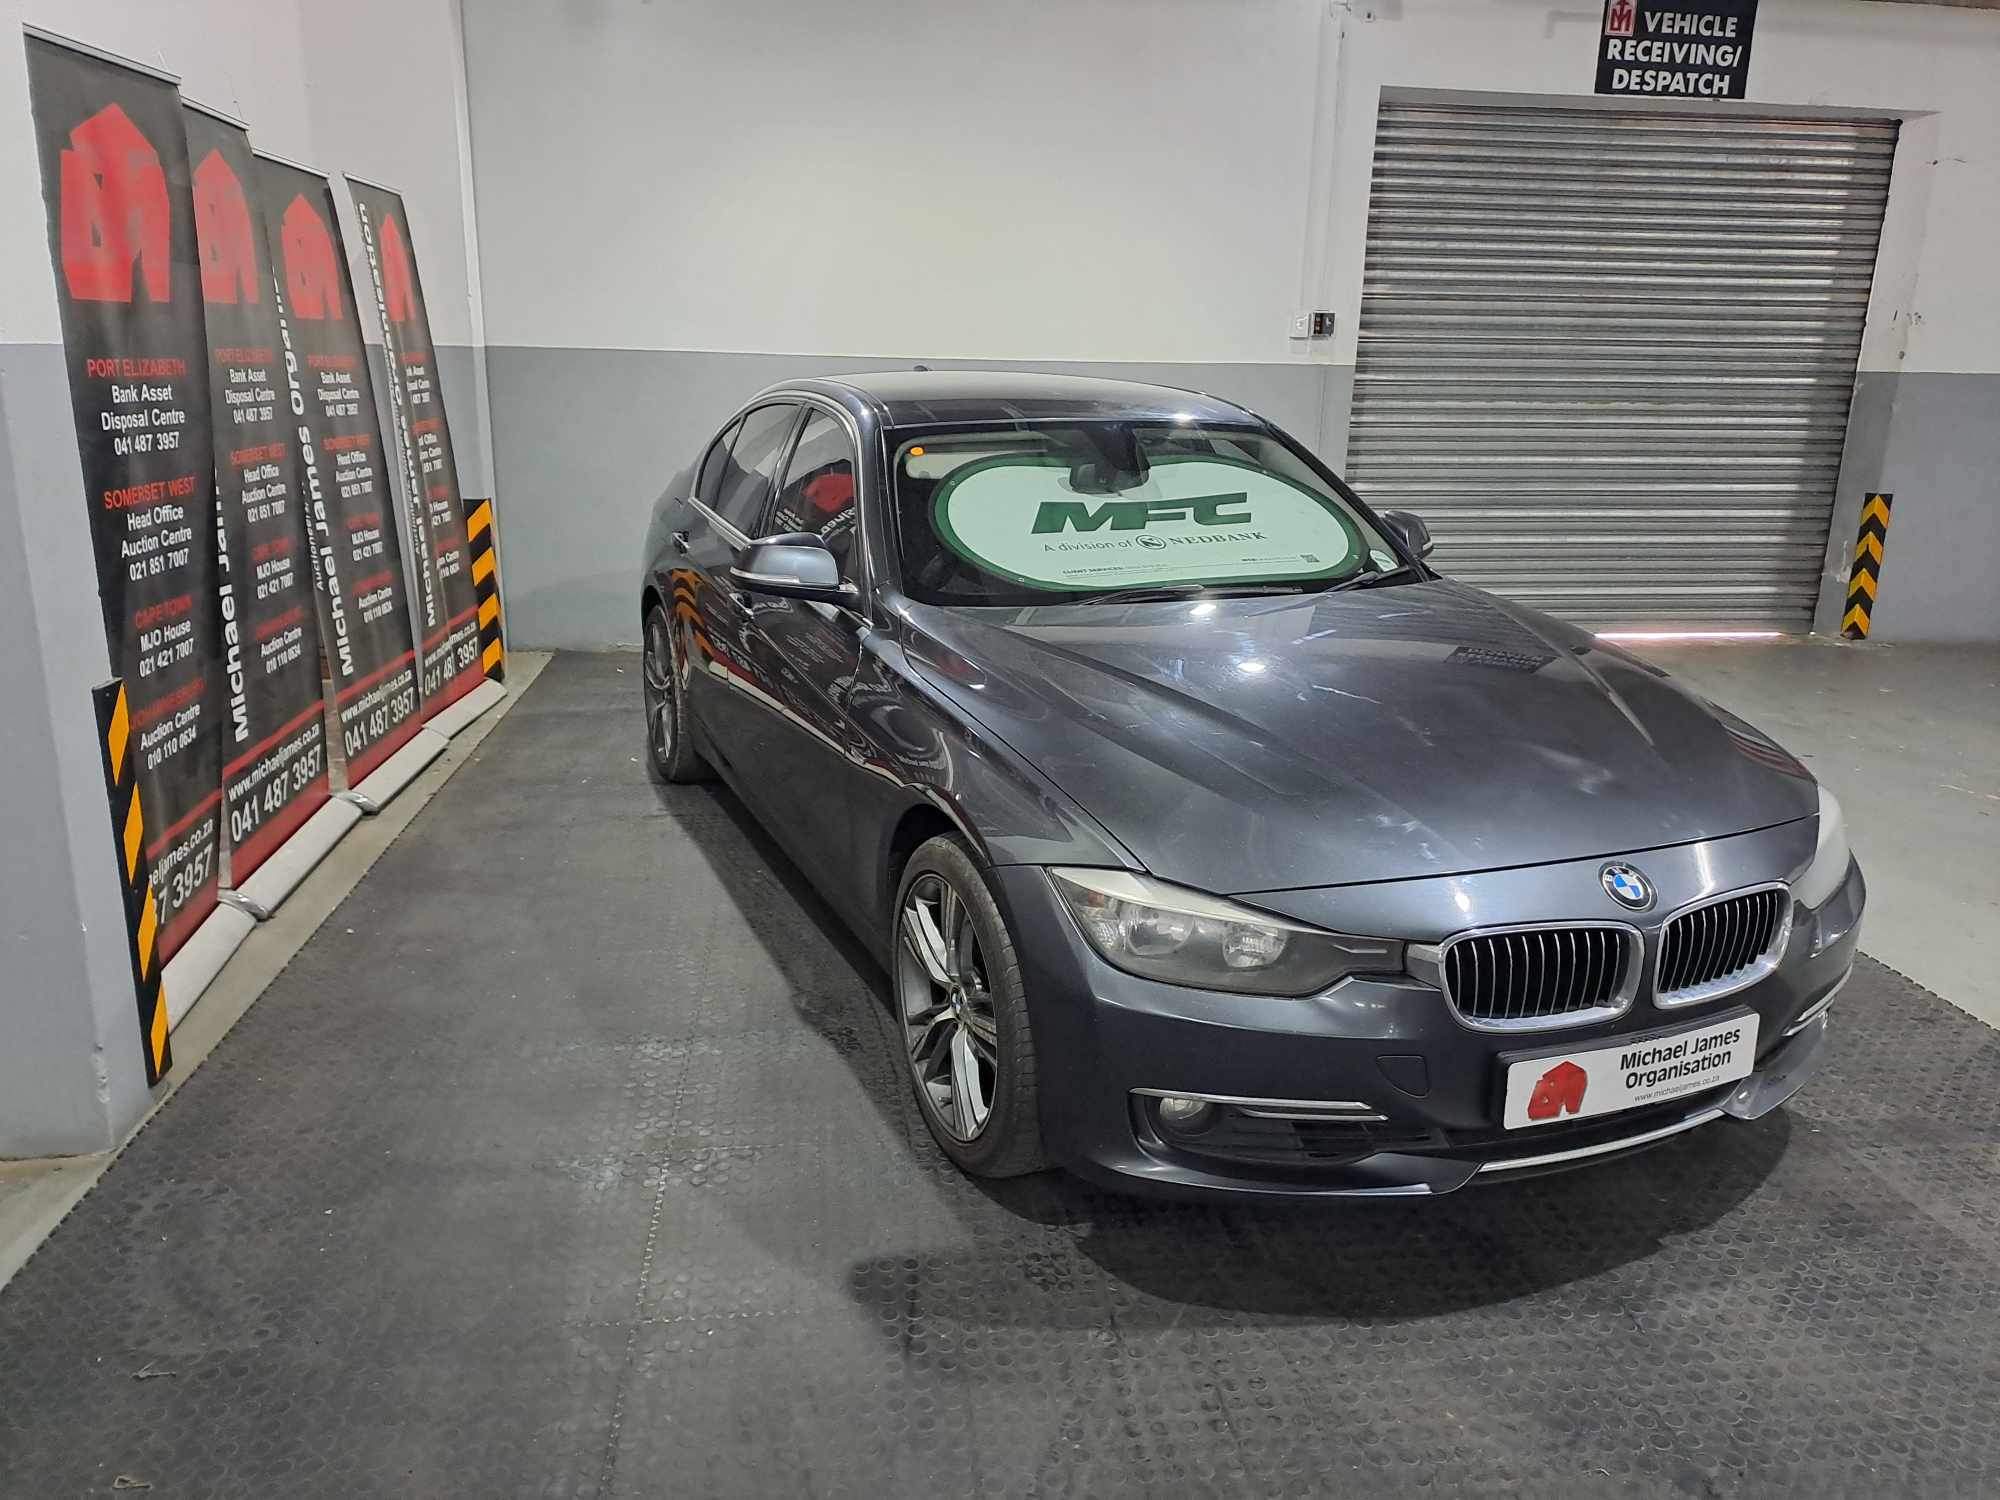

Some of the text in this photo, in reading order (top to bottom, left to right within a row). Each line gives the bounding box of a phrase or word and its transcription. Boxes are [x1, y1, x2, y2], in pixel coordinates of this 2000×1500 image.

[1644, 11, 1738, 38] VEHICLE
[1607, 38, 1743, 68] RECEIVING/
[1611, 68, 1731, 96] DESPATCH
[87, 358, 186, 377] PORT ELIZABETH
[111, 383, 173, 404] Bank Asset
[101, 408, 185, 433] Disposal Centre
[113, 431, 180, 456] 041 487 3957
[103, 476, 196, 510] SOMERSET WEST
[126, 504, 184, 532] Head Office
[1031, 492, 1252, 534] MFC
[121, 526, 192, 559] Auction Centre
[298, 425, 354, 677] Michael James
[1043, 531, 1268, 553] A division of NEDBANK
[129, 547, 189, 582] 021 851 7007
[140, 619, 192, 653] MJO House
[139, 637, 195, 678] 021 421 7007
[218, 583, 249, 743] Michael
[424, 664, 442, 697] 041
[457, 635, 479, 669] 3957
[140, 719, 174, 751] Auction
[175, 702, 201, 730] Centre
[344, 685, 415, 758] 041 487 3957
[147, 745, 162, 770] 010
[163, 737, 178, 760] 110
[231, 743, 322, 843] 041 487 3957
[152, 842, 213, 925] 7 3957
[1619, 1027, 1741, 1071] Michael James
[1625, 1050, 1732, 1090] Organisation
